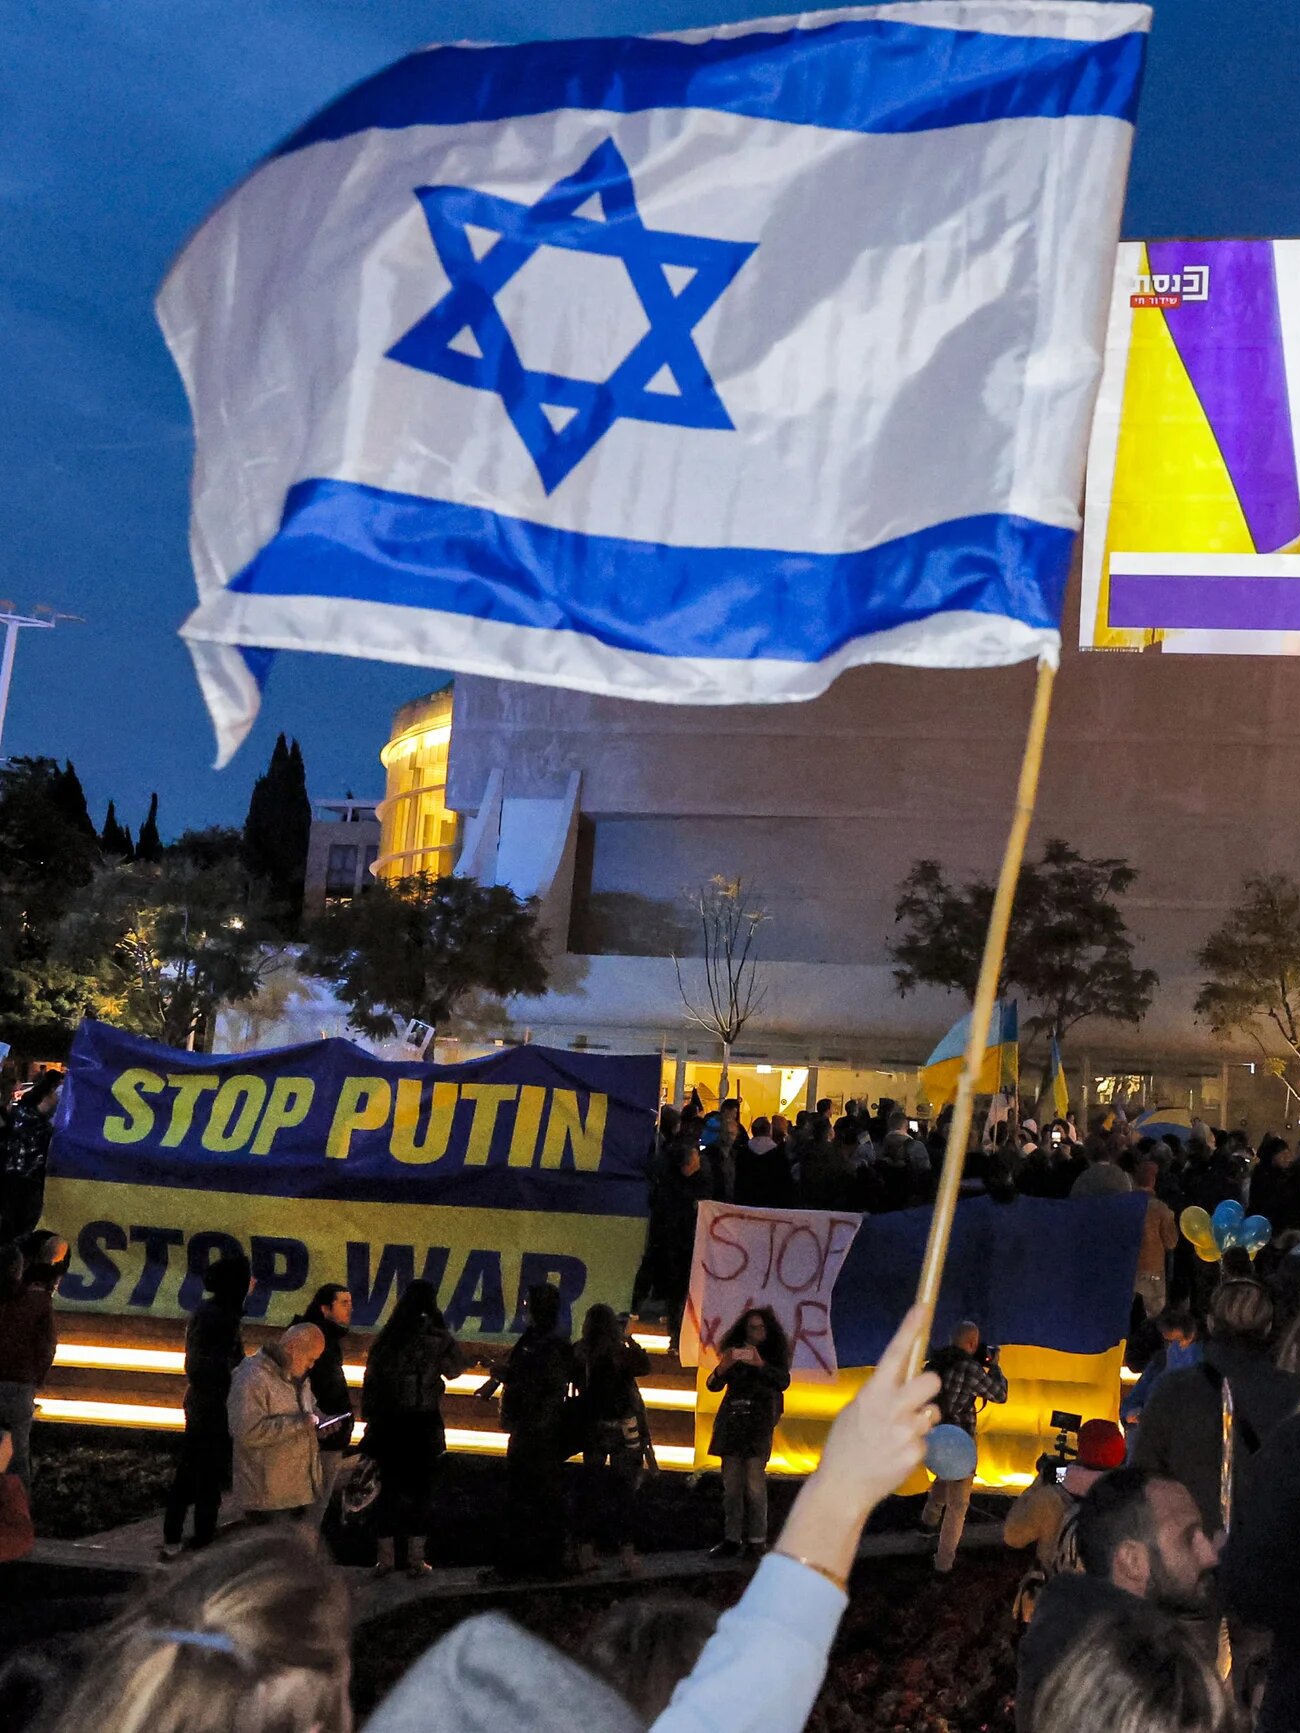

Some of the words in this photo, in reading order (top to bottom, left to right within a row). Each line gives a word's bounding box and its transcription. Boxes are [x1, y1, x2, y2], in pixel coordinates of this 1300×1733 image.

[1135, 297, 1145, 305] חי
[1149, 297, 1178, 305] שידור
[102, 1067, 315, 1156] STOP
[325, 1076, 608, 1172] PUTIN
[58, 1220, 309, 1318] STOP
[346, 1241, 588, 1340] WAR
[701, 1213, 857, 1293] STOP
[687, 1292, 832, 1376] WR
